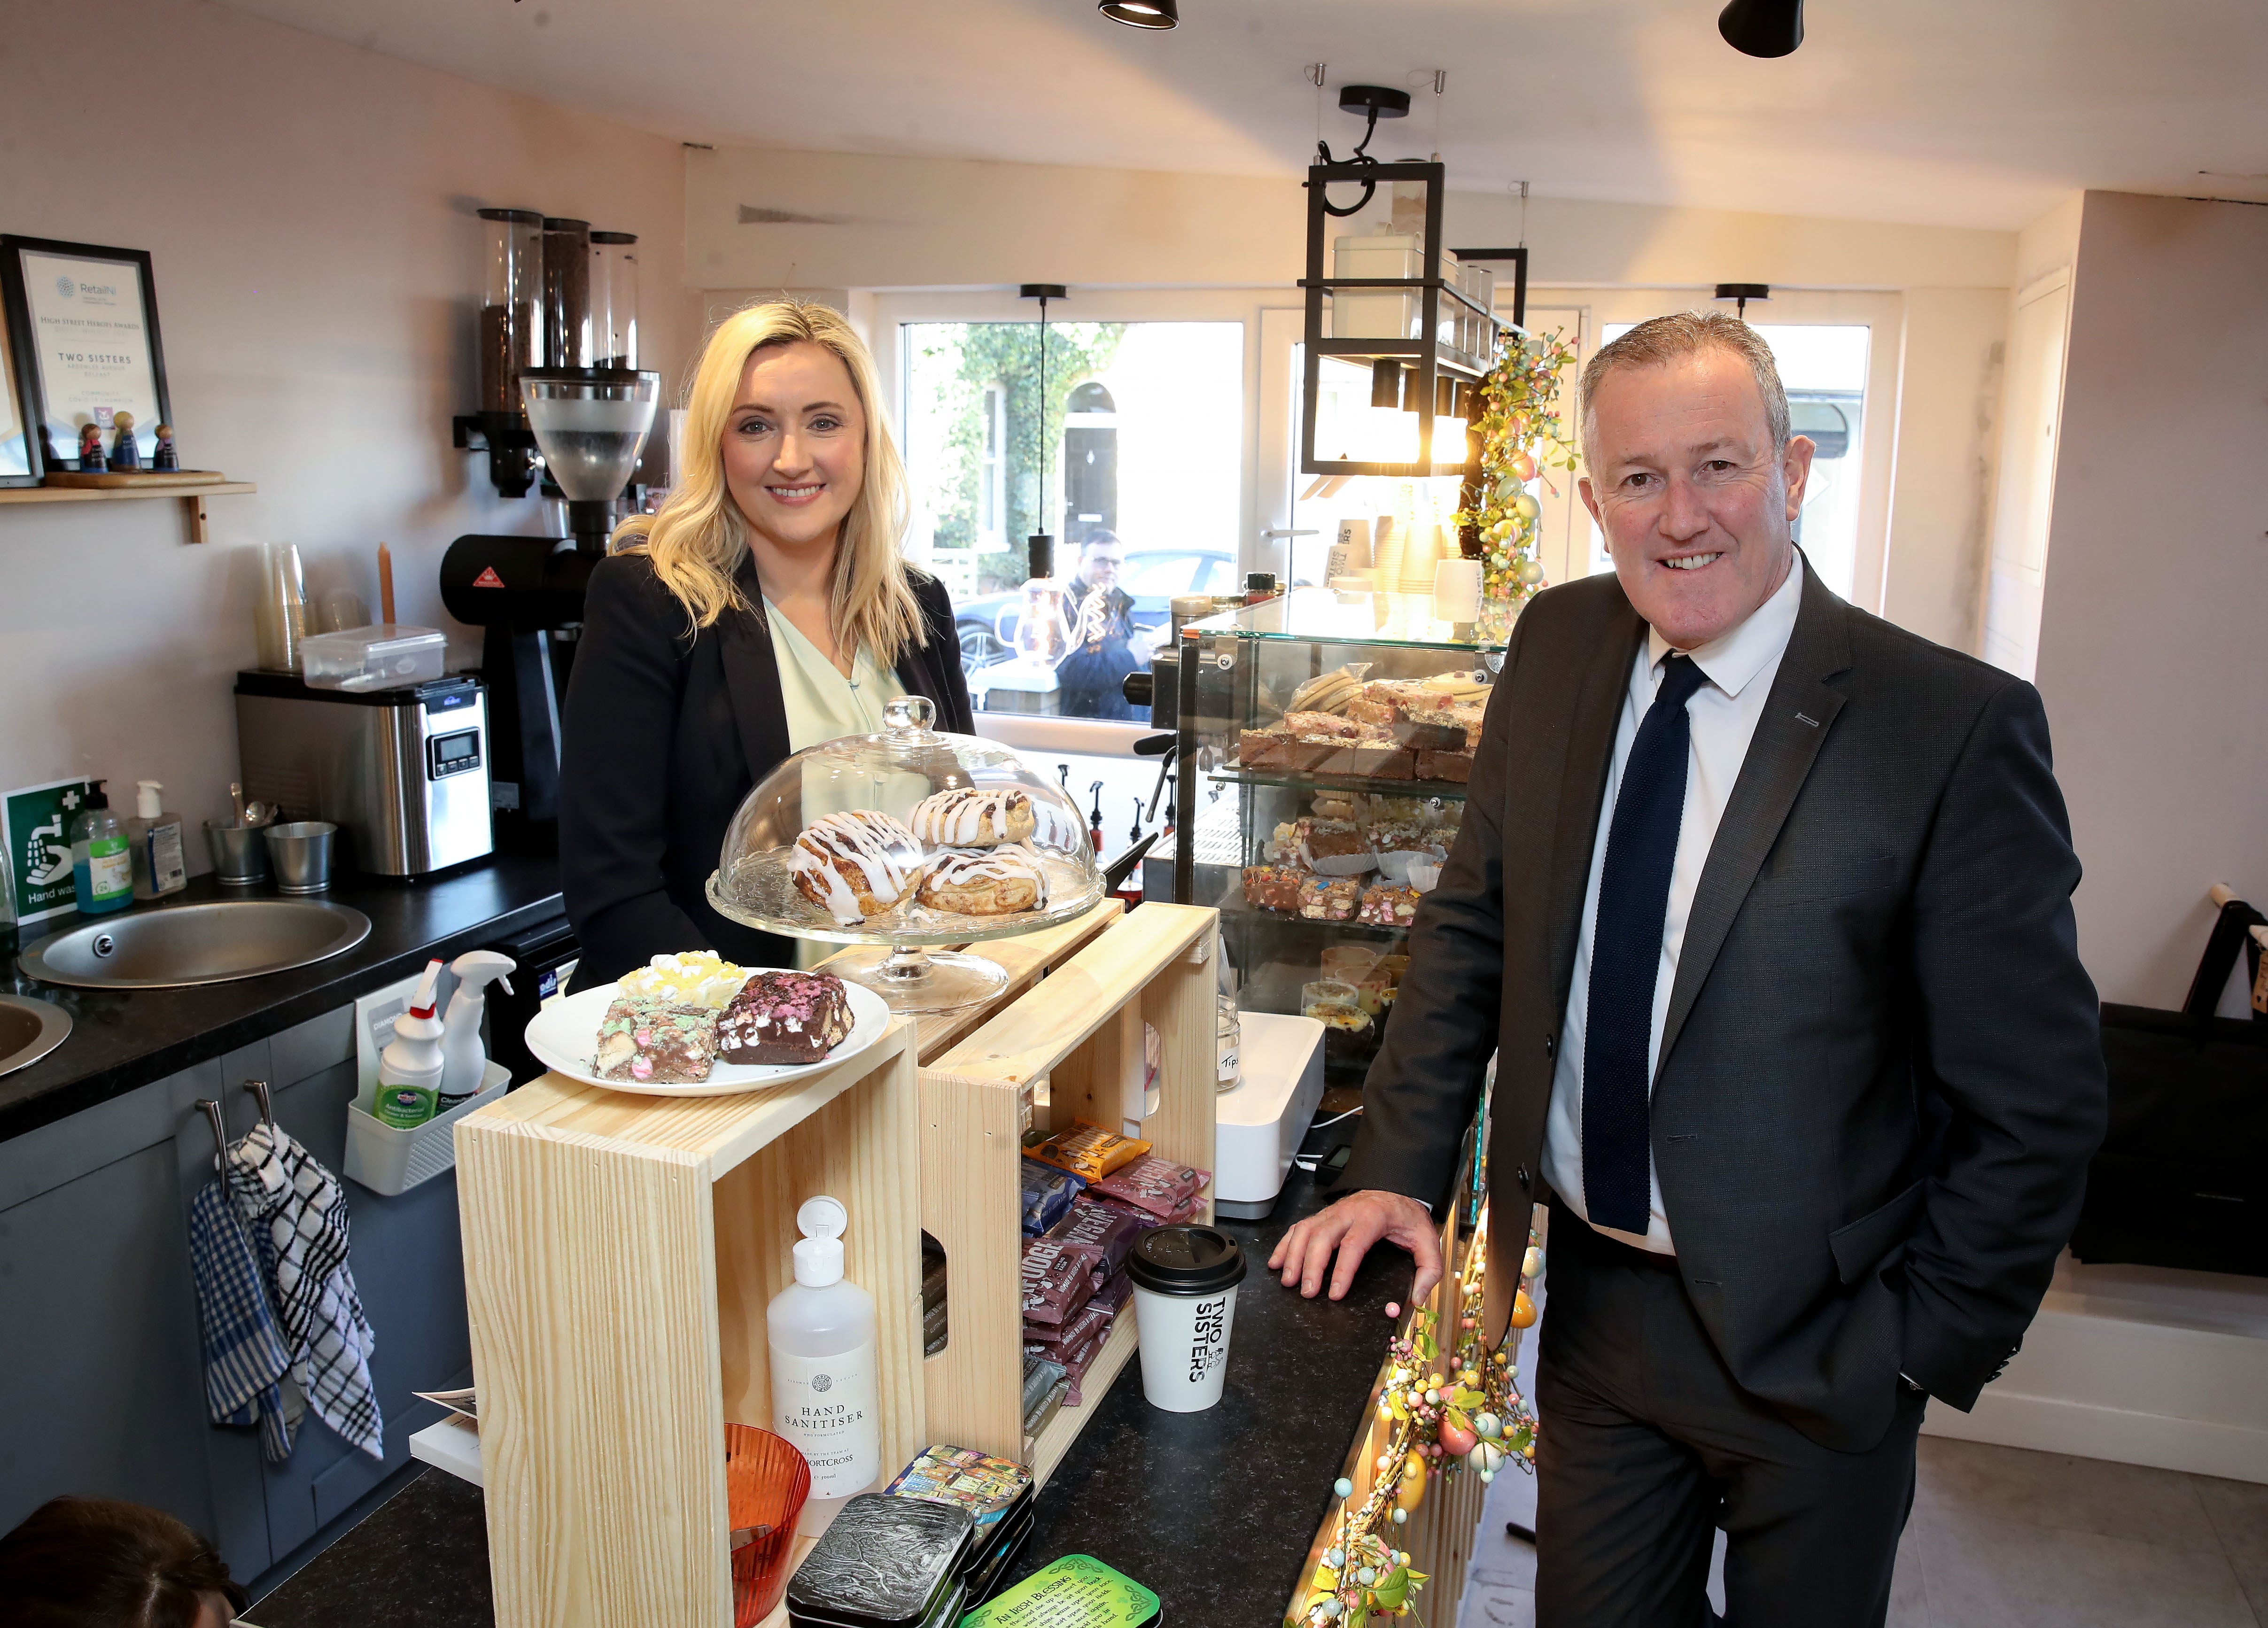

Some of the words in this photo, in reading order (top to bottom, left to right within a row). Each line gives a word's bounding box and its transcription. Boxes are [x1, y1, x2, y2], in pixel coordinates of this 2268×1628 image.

[80, 283, 117, 295] RetailNI
[58, 353, 83, 362] TWO
[88, 355, 132, 364] SISTERS
[1327, 551, 1339, 587] SISTE
[1336, 553, 1347, 575] TWO
[28, 888, 55, 904] Hand
[57, 885, 75, 896] was
[1221, 1055, 1239, 1069] Tips
[1022, 1241, 1064, 1287] FUDGE
[930, 1322, 940, 1333] GLUTEN
[1210, 1296, 1226, 1343] TWO
[1189, 1303, 1212, 1382] SISTERS
[785, 1411, 863, 1429] SANITISER
[801, 1405, 845, 1416] HAND
[807, 1454, 853, 1466] HORTCROSS
[994, 1613, 1011, 1624] AN
[1008, 1599, 1033, 1614] IRISH
[1031, 1575, 1072, 1601] BLESSING
[1022, 1610, 1034, 1619] road
[1063, 1583, 1077, 1593] meet
[1023, 1617, 1037, 1627] wind
[1038, 1604, 1058, 1618] always
[1075, 1586, 1087, 1594] your
[1040, 1616, 1054, 1627] shine
[1056, 1606, 1071, 1616] warm
[1071, 1596, 1085, 1606] upon
[1086, 1588, 1099, 1596] your
[1056, 1617, 1066, 1626] soft
[1067, 1608, 1082, 1618] upon
[1082, 1599, 1095, 1608] your
[1075, 1612, 1090, 1622] meet
